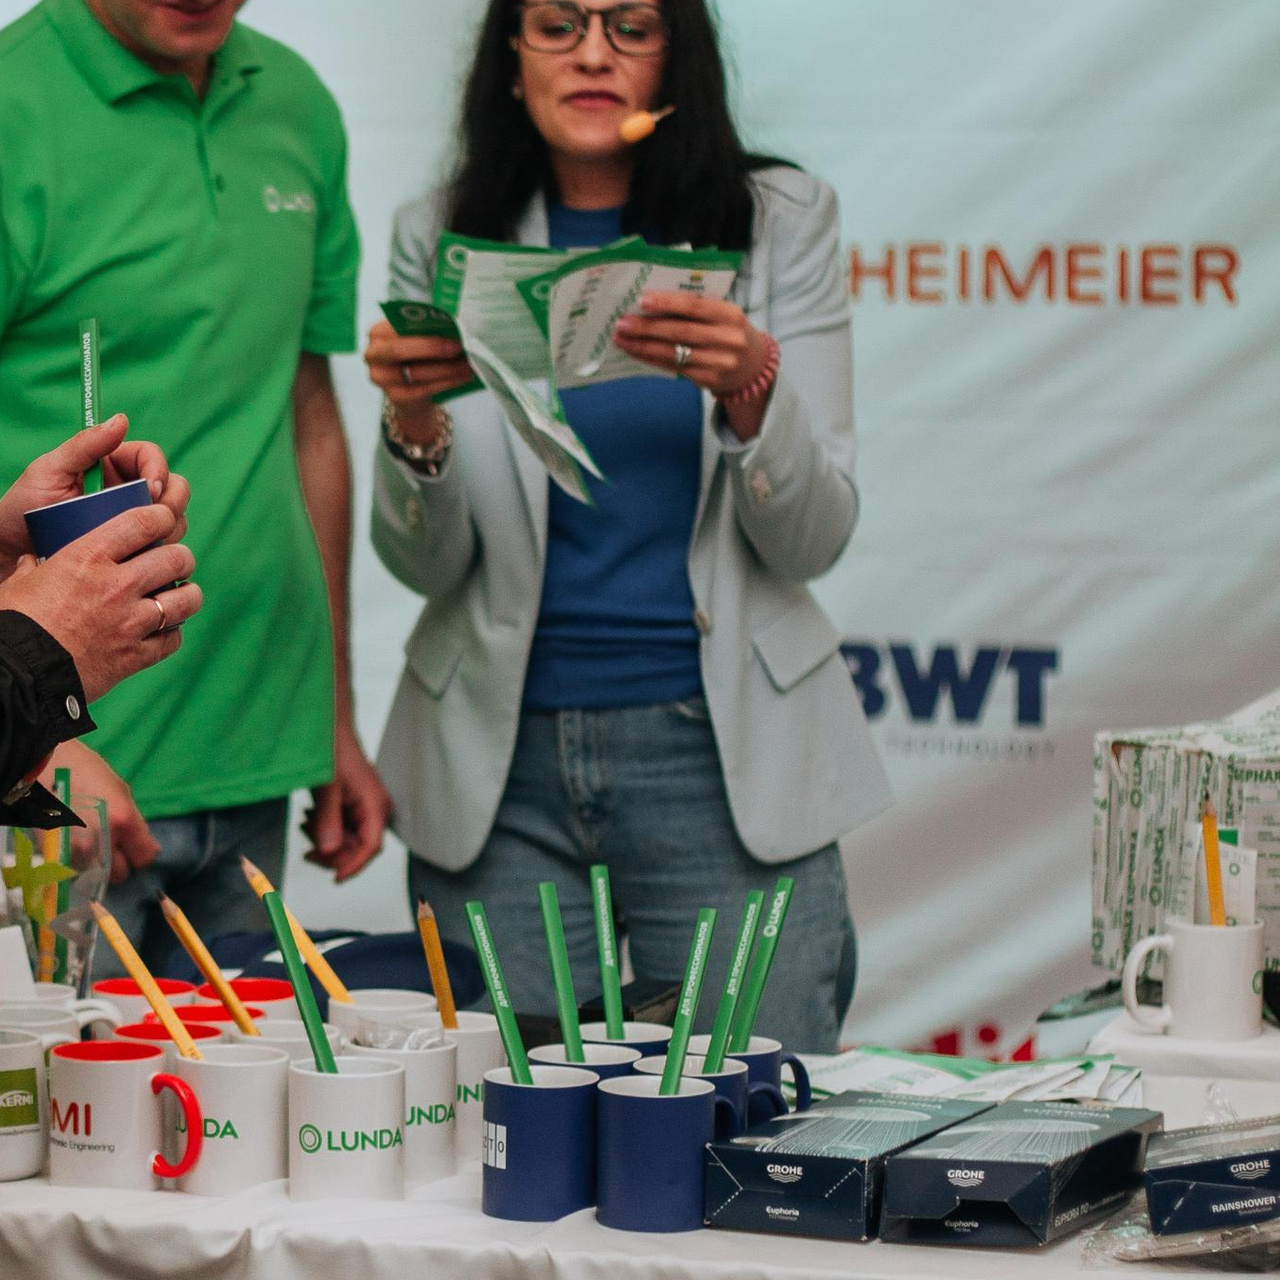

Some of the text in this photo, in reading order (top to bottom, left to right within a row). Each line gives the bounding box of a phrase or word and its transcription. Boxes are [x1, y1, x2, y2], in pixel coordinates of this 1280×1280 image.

[849, 244, 1240, 307] HEIMEIER
[83, 332, 93, 409] ПРОФЕССИОНАЛОВ
[839, 640, 1059, 727] BWT
[769, 891, 787, 925] LUNDA
[51, 1098, 91, 1136] MI
[405, 1103, 456, 1125] UNDA
[175, 1114, 239, 1139] LUDA
[327, 1127, 403, 1152] LUNDA
[766, 1164, 803, 1176] GROHE
[947, 1169, 985, 1180] GROHE
[1230, 1159, 1271, 1173] GROHE
[765, 1205, 800, 1217] Euphoria
[1211, 1195, 1276, 1213] RAINSHOWER
[944, 1220, 979, 1228] Euphoria
